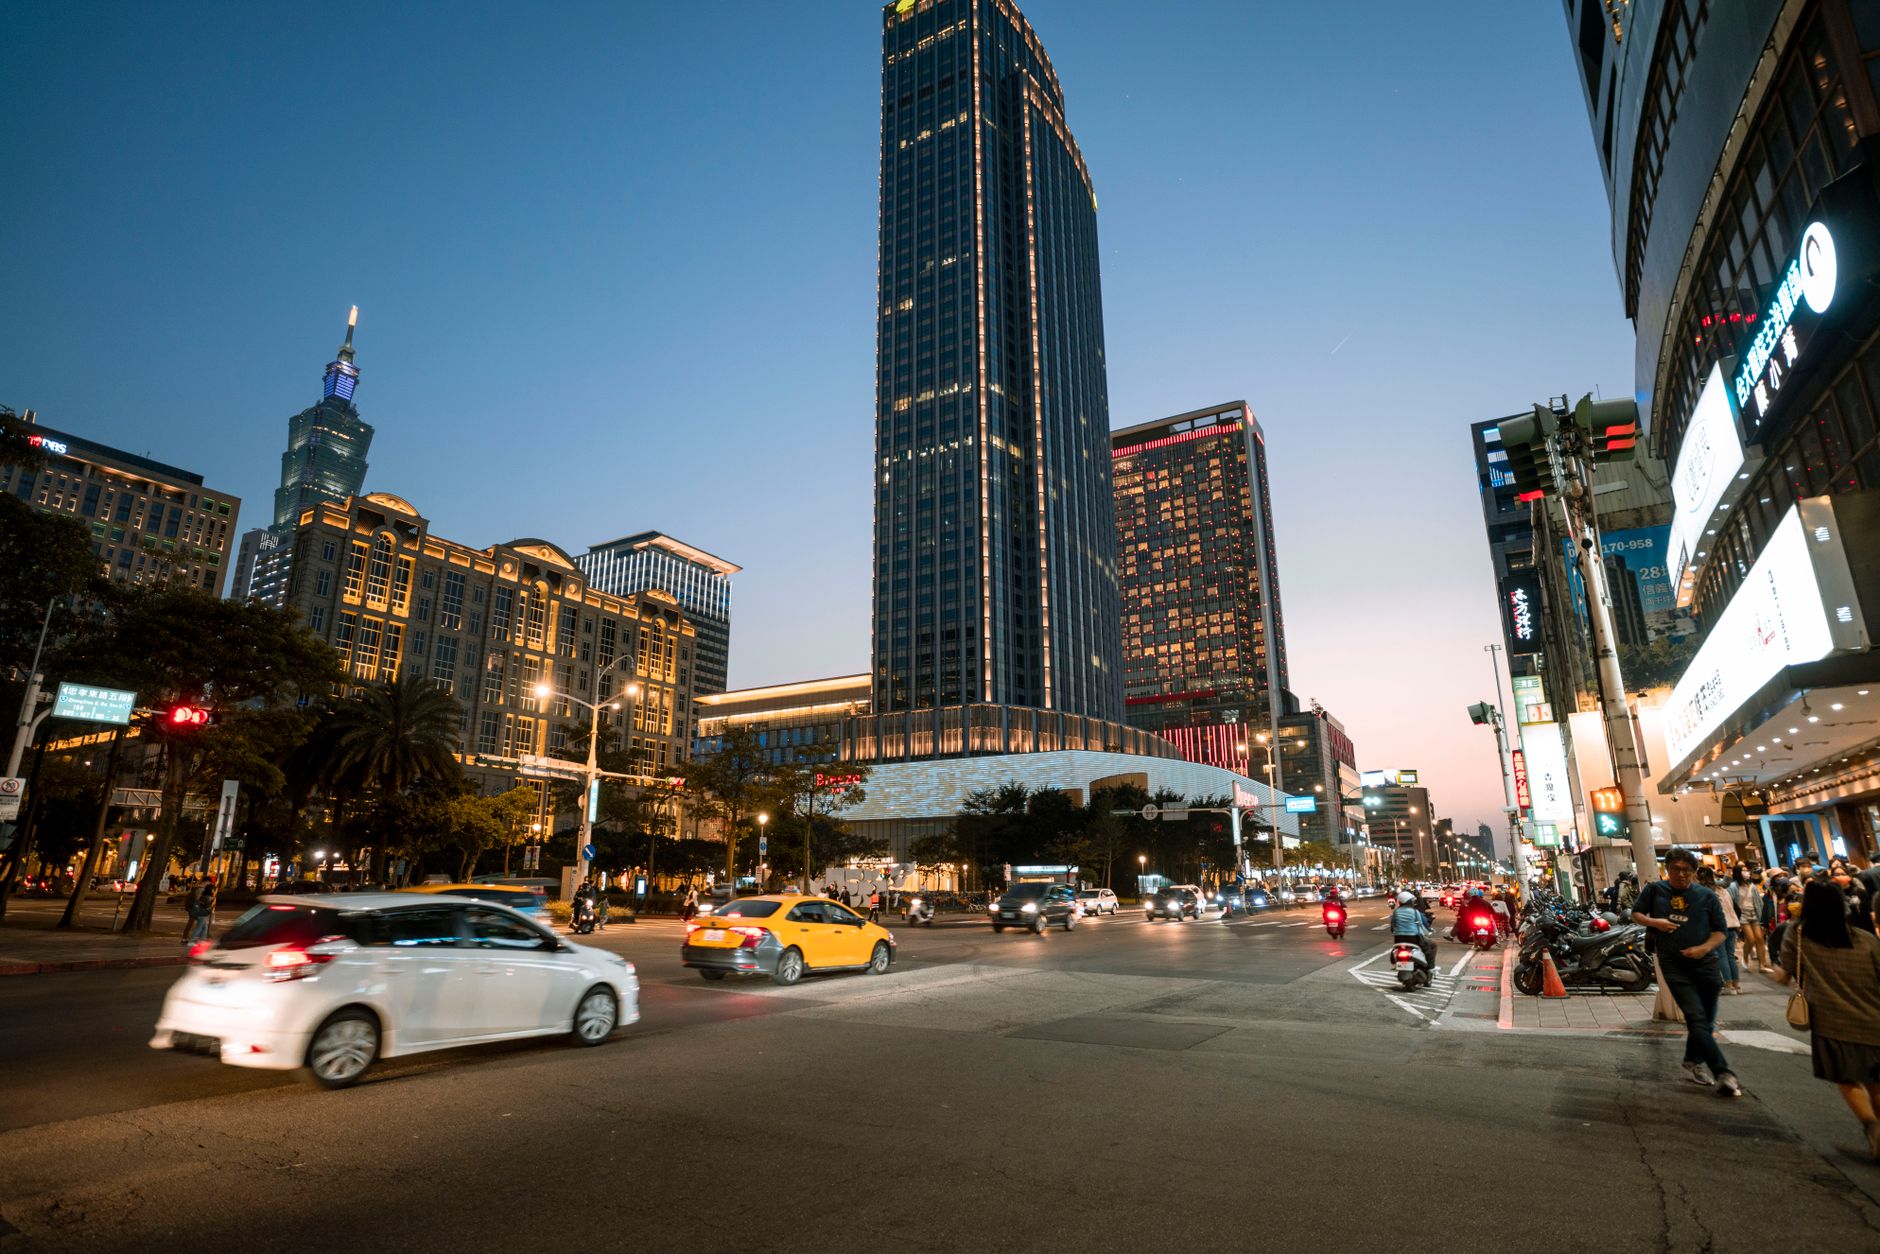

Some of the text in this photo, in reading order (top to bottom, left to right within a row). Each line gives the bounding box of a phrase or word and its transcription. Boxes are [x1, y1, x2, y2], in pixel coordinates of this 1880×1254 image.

[42, 438, 67, 454] DBS
[68, 687, 127, 702] 忠孝東路五段
[1234, 783, 1259, 807] Breeze
